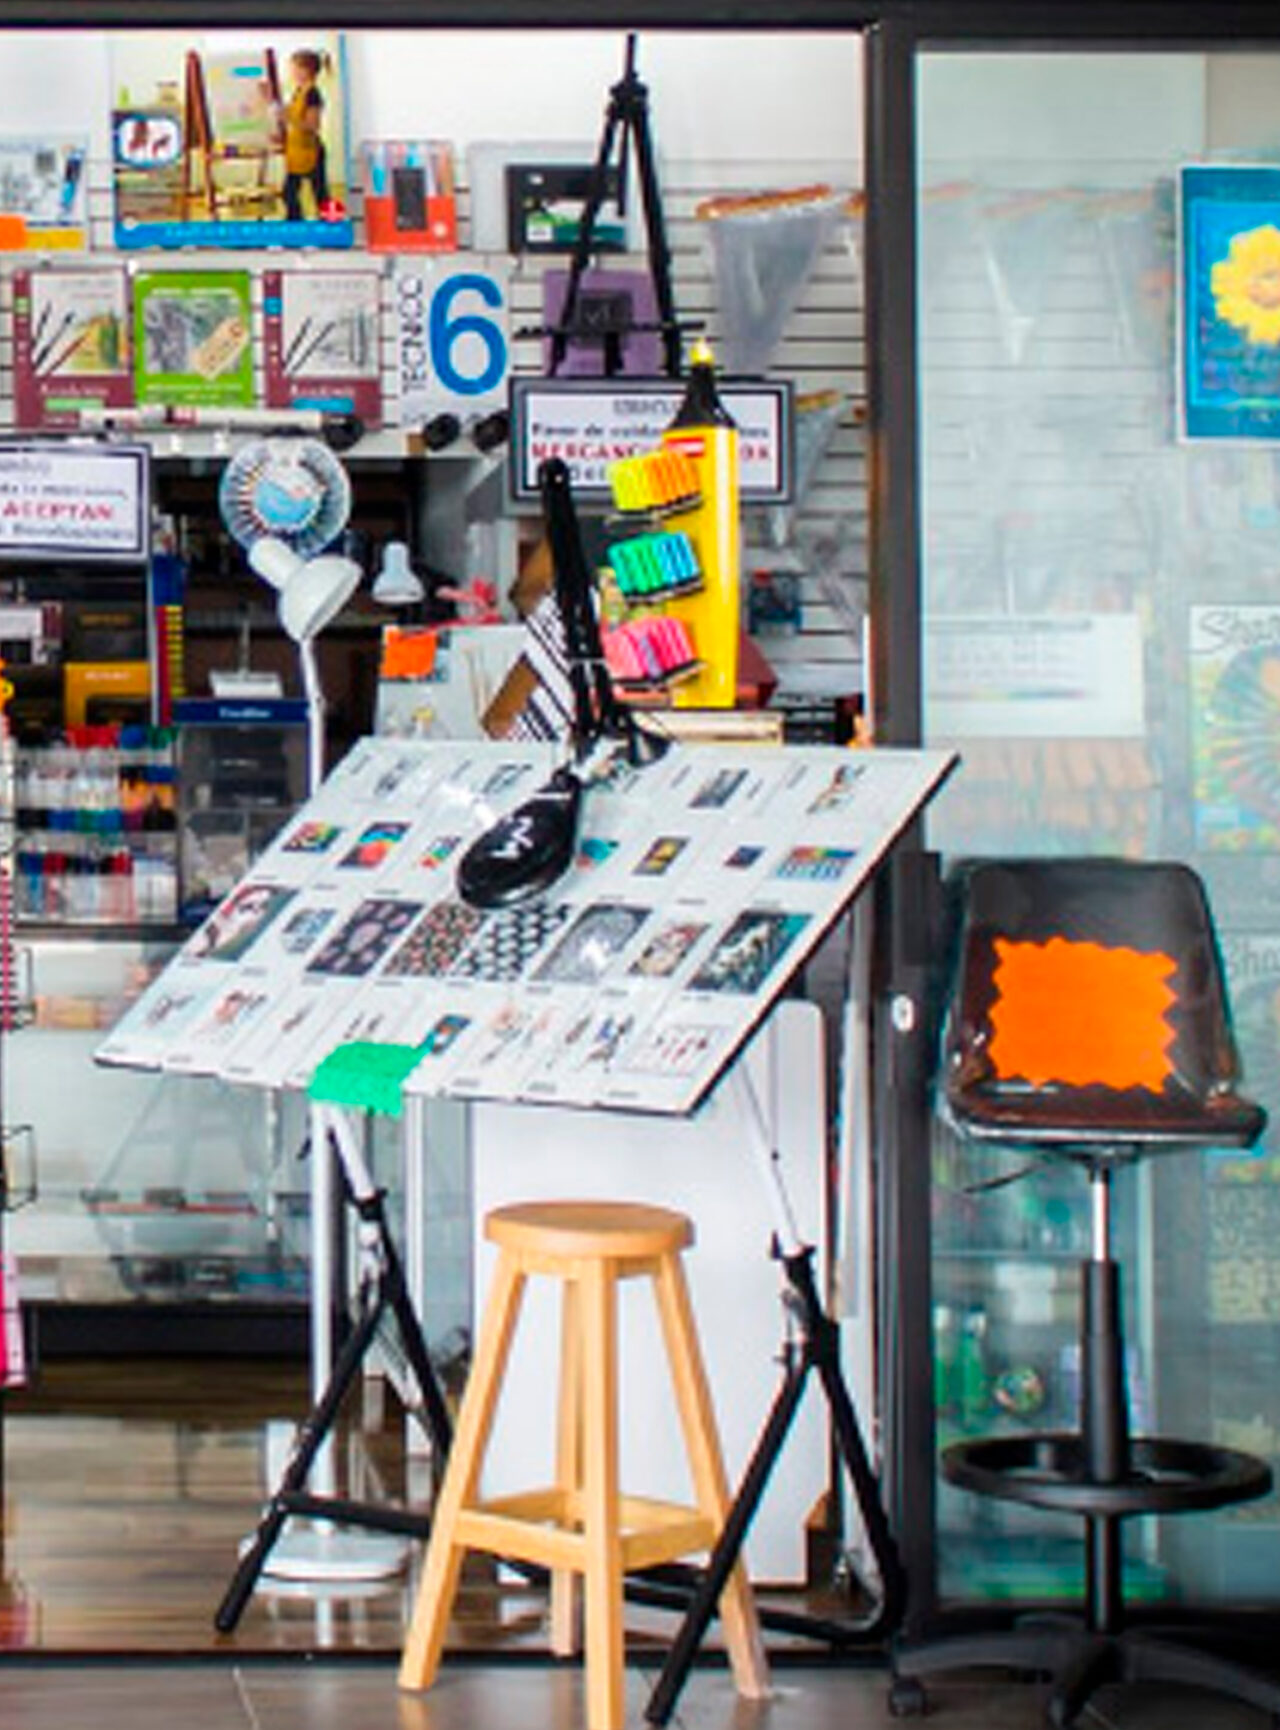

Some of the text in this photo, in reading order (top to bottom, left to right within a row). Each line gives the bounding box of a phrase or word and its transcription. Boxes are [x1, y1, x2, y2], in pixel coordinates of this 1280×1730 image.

[429, 273, 508, 397] 6
[584, 422, 604, 436] de
[3, 501, 113, 520] ACEPTAN
